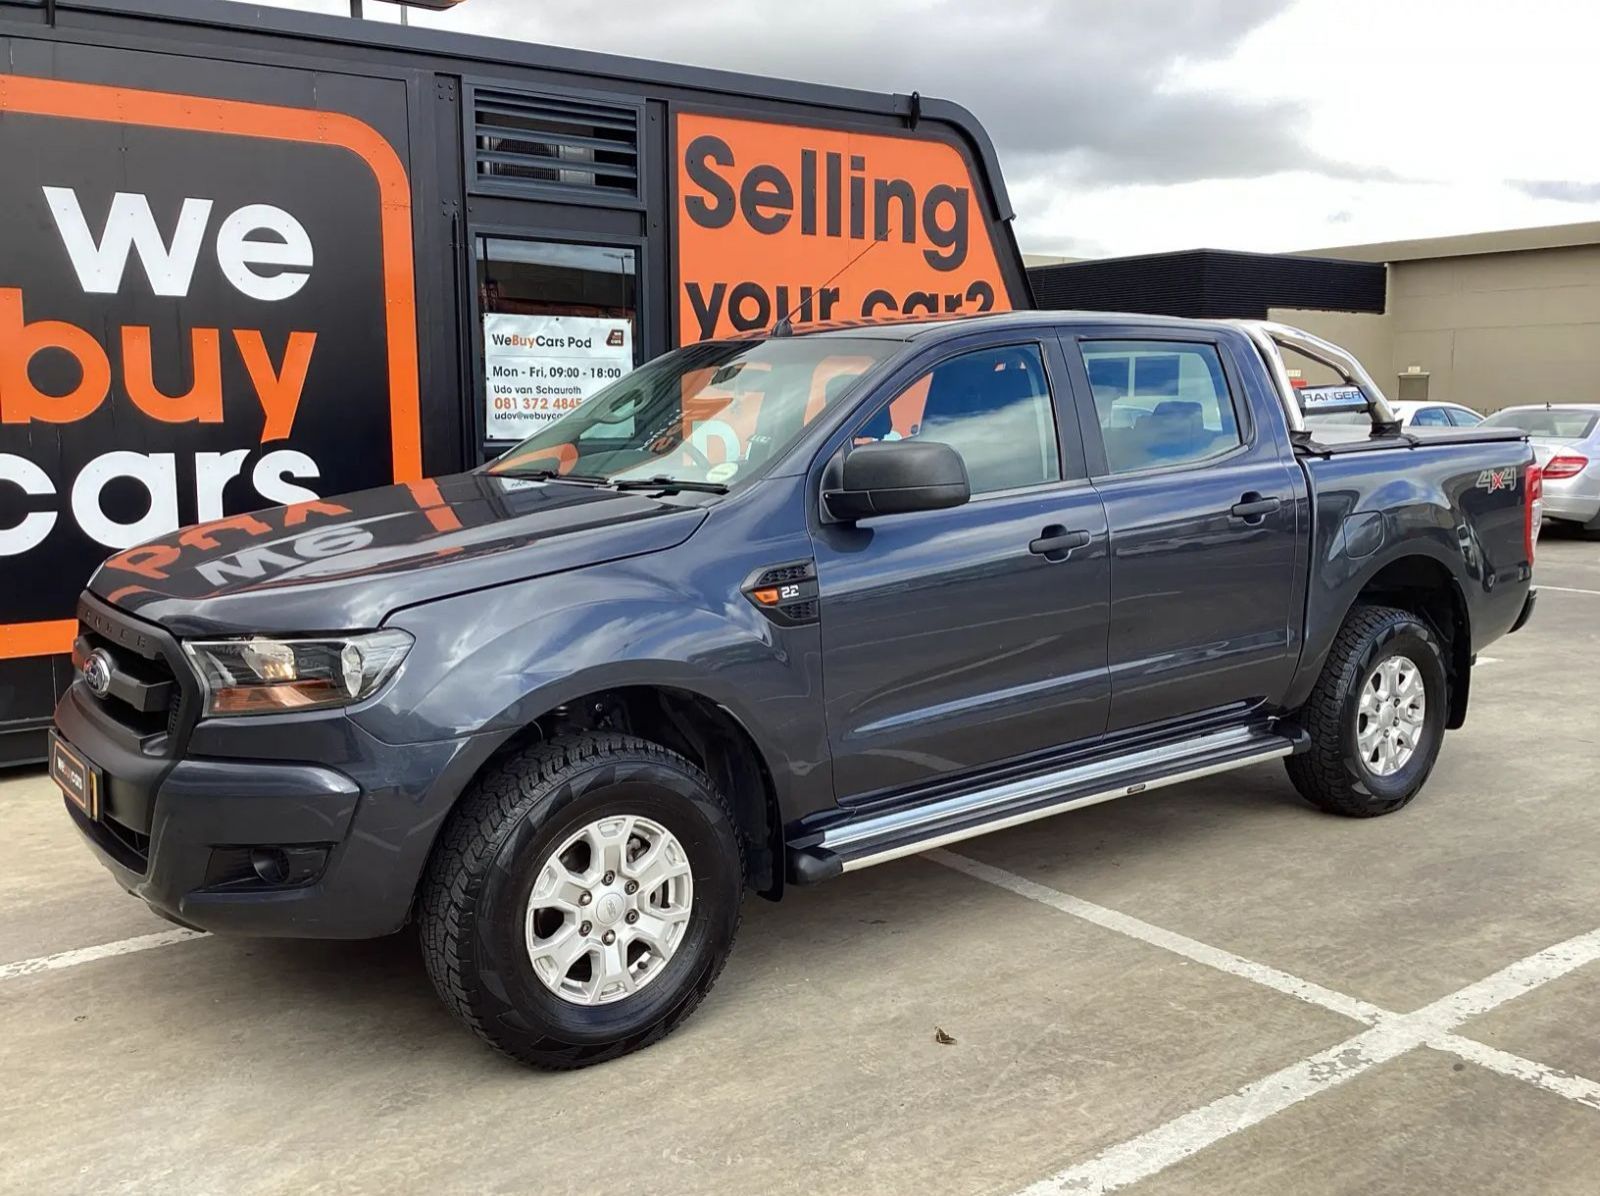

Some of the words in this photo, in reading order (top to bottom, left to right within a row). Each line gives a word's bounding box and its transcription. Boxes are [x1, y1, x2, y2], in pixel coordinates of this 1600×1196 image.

[684, 135, 969, 272] Selling
[42, 185, 314, 301] we
[492, 334, 565, 348] WeBuyCars
[567, 336, 592, 348] Pod
[684, 281, 839, 341] your
[0, 287, 317, 443] buy
[493, 366, 518, 377] Mon
[530, 367, 547, 379] Fri,
[550, 367, 580, 378] 09:00
[591, 368, 621, 378] 18:00
[494, 385, 512, 394] Udo
[536, 386, 582, 395] Schauroth
[494, 397, 518, 410] 081
[523, 397, 548, 410] 372
[0, 449, 321, 556] cars
